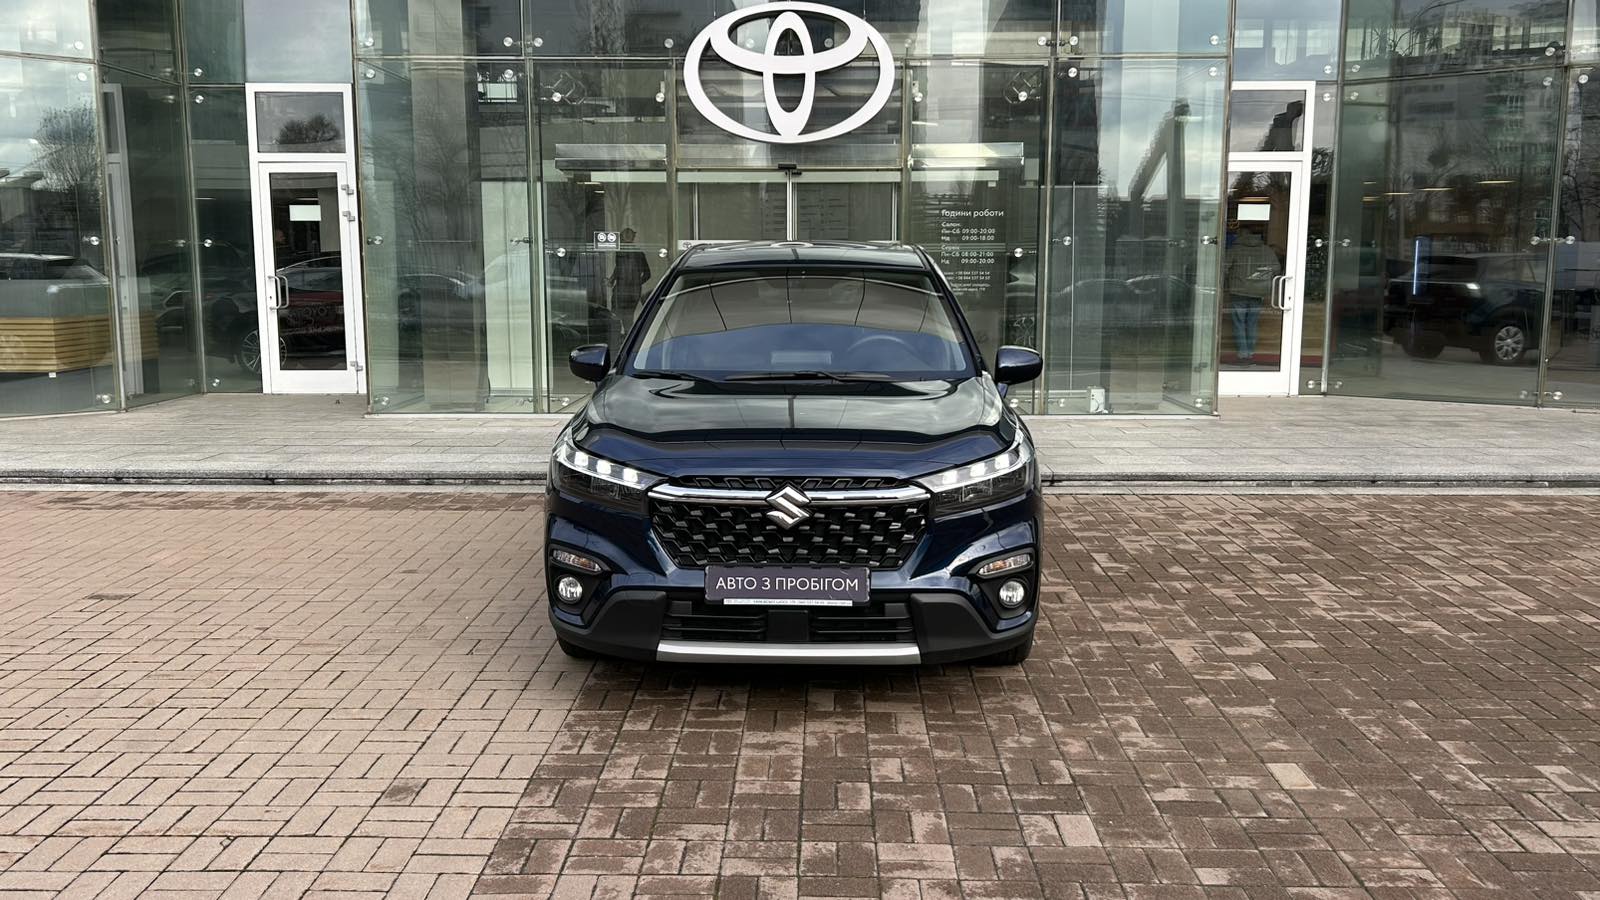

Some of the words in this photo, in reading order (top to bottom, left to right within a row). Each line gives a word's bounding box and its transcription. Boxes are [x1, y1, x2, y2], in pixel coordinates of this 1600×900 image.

[941, 209, 971, 217] Години
[973, 208, 1004, 218] роботи
[715, 576, 757, 590] АВТО
[761, 577, 771, 590] З
[775, 577, 859, 591] ПРОБІГОМ
